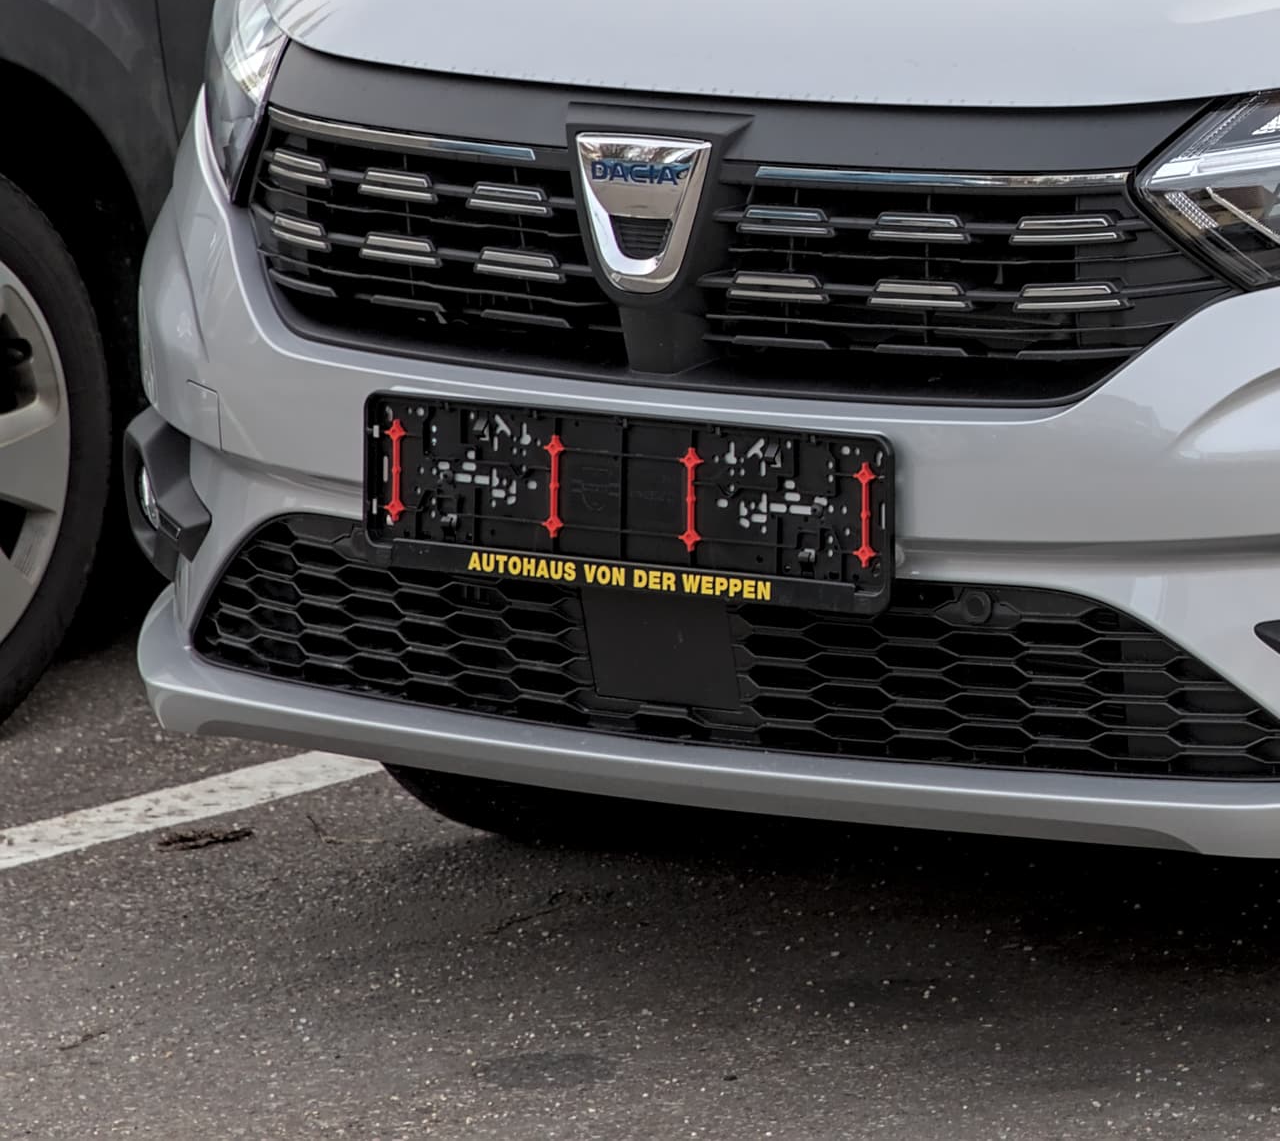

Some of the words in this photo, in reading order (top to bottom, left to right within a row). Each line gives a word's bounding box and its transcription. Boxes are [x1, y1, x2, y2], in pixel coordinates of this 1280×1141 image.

[591, 161, 679, 186] DACIA
[467, 551, 577, 582] AUTOHAUS
[583, 563, 626, 587] VON
[633, 568, 676, 592] DER
[681, 573, 772, 601] WEPPEN
